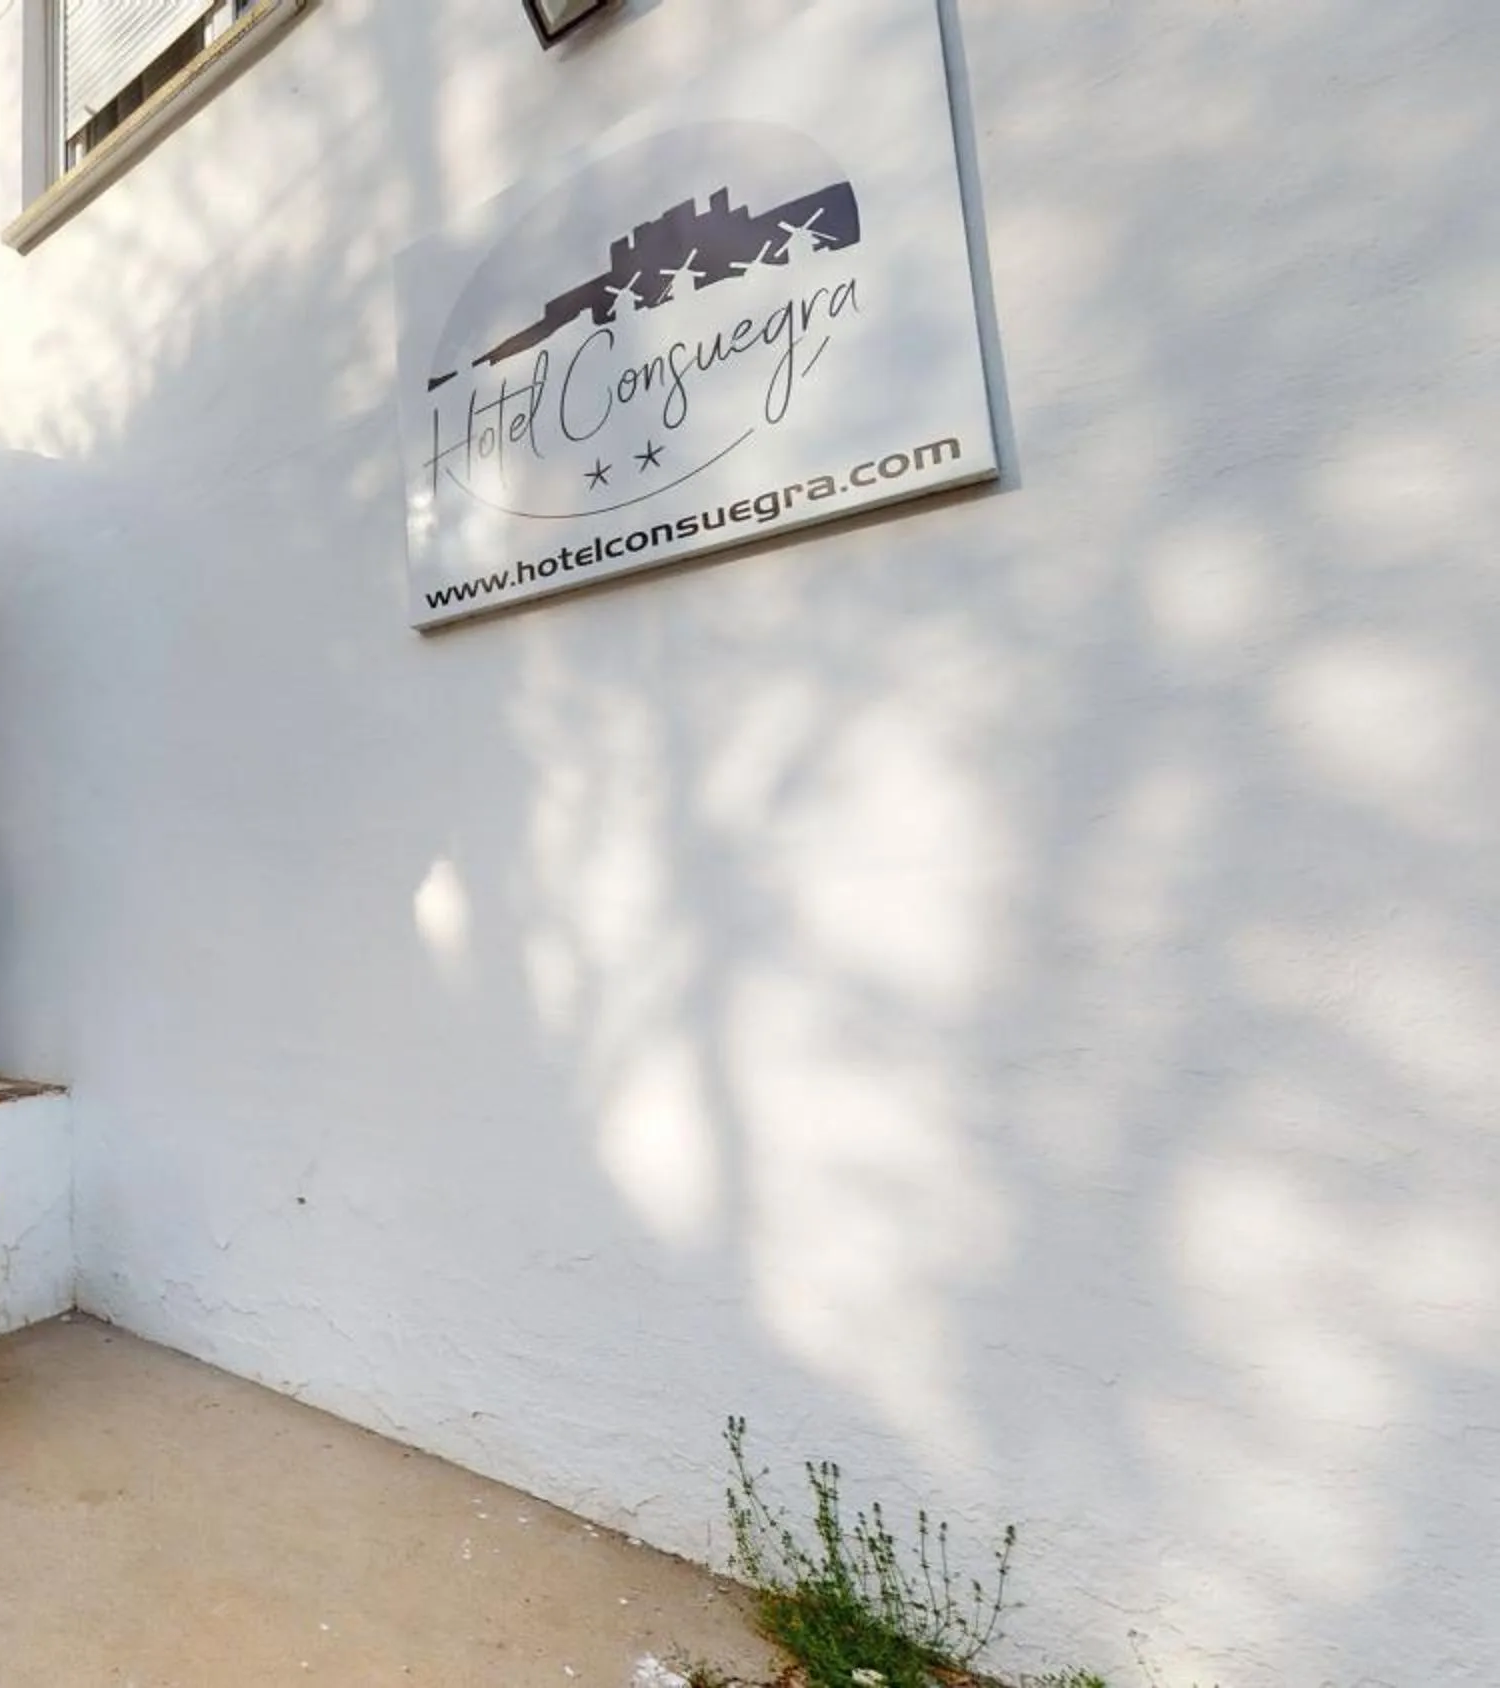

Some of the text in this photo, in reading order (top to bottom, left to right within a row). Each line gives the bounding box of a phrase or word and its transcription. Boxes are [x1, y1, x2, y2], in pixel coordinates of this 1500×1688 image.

[424, 278, 861, 499] Hotel Consuegra
[425, 435, 962, 609] www.hotelconsuegra.com
